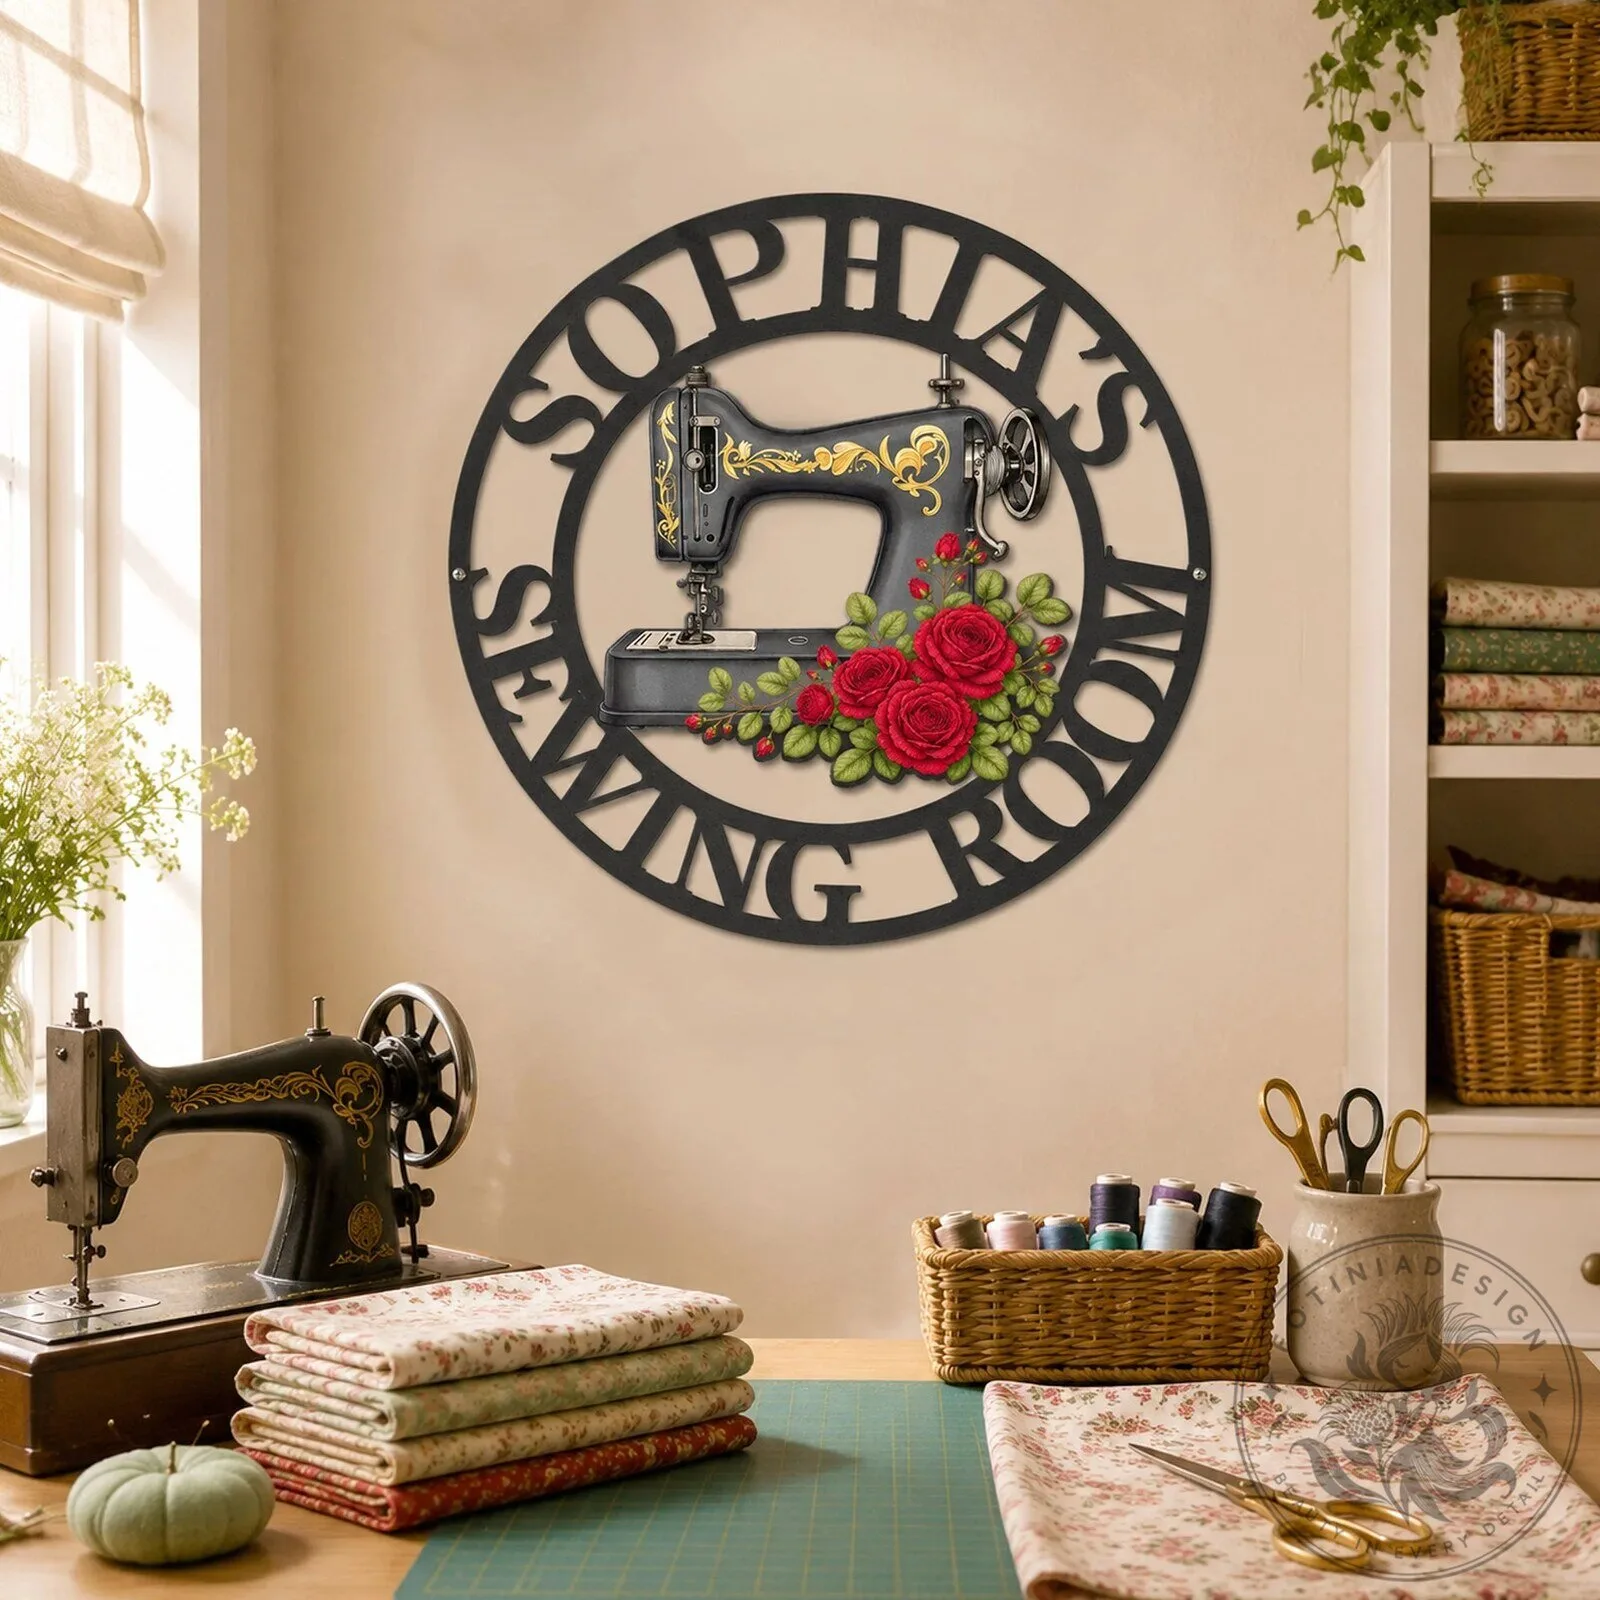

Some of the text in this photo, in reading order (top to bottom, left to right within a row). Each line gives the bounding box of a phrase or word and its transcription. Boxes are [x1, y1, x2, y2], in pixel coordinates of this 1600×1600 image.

[499, 214, 1158, 471] SOPHIA'S
[469, 545, 1190, 925] SEWING ROOM
